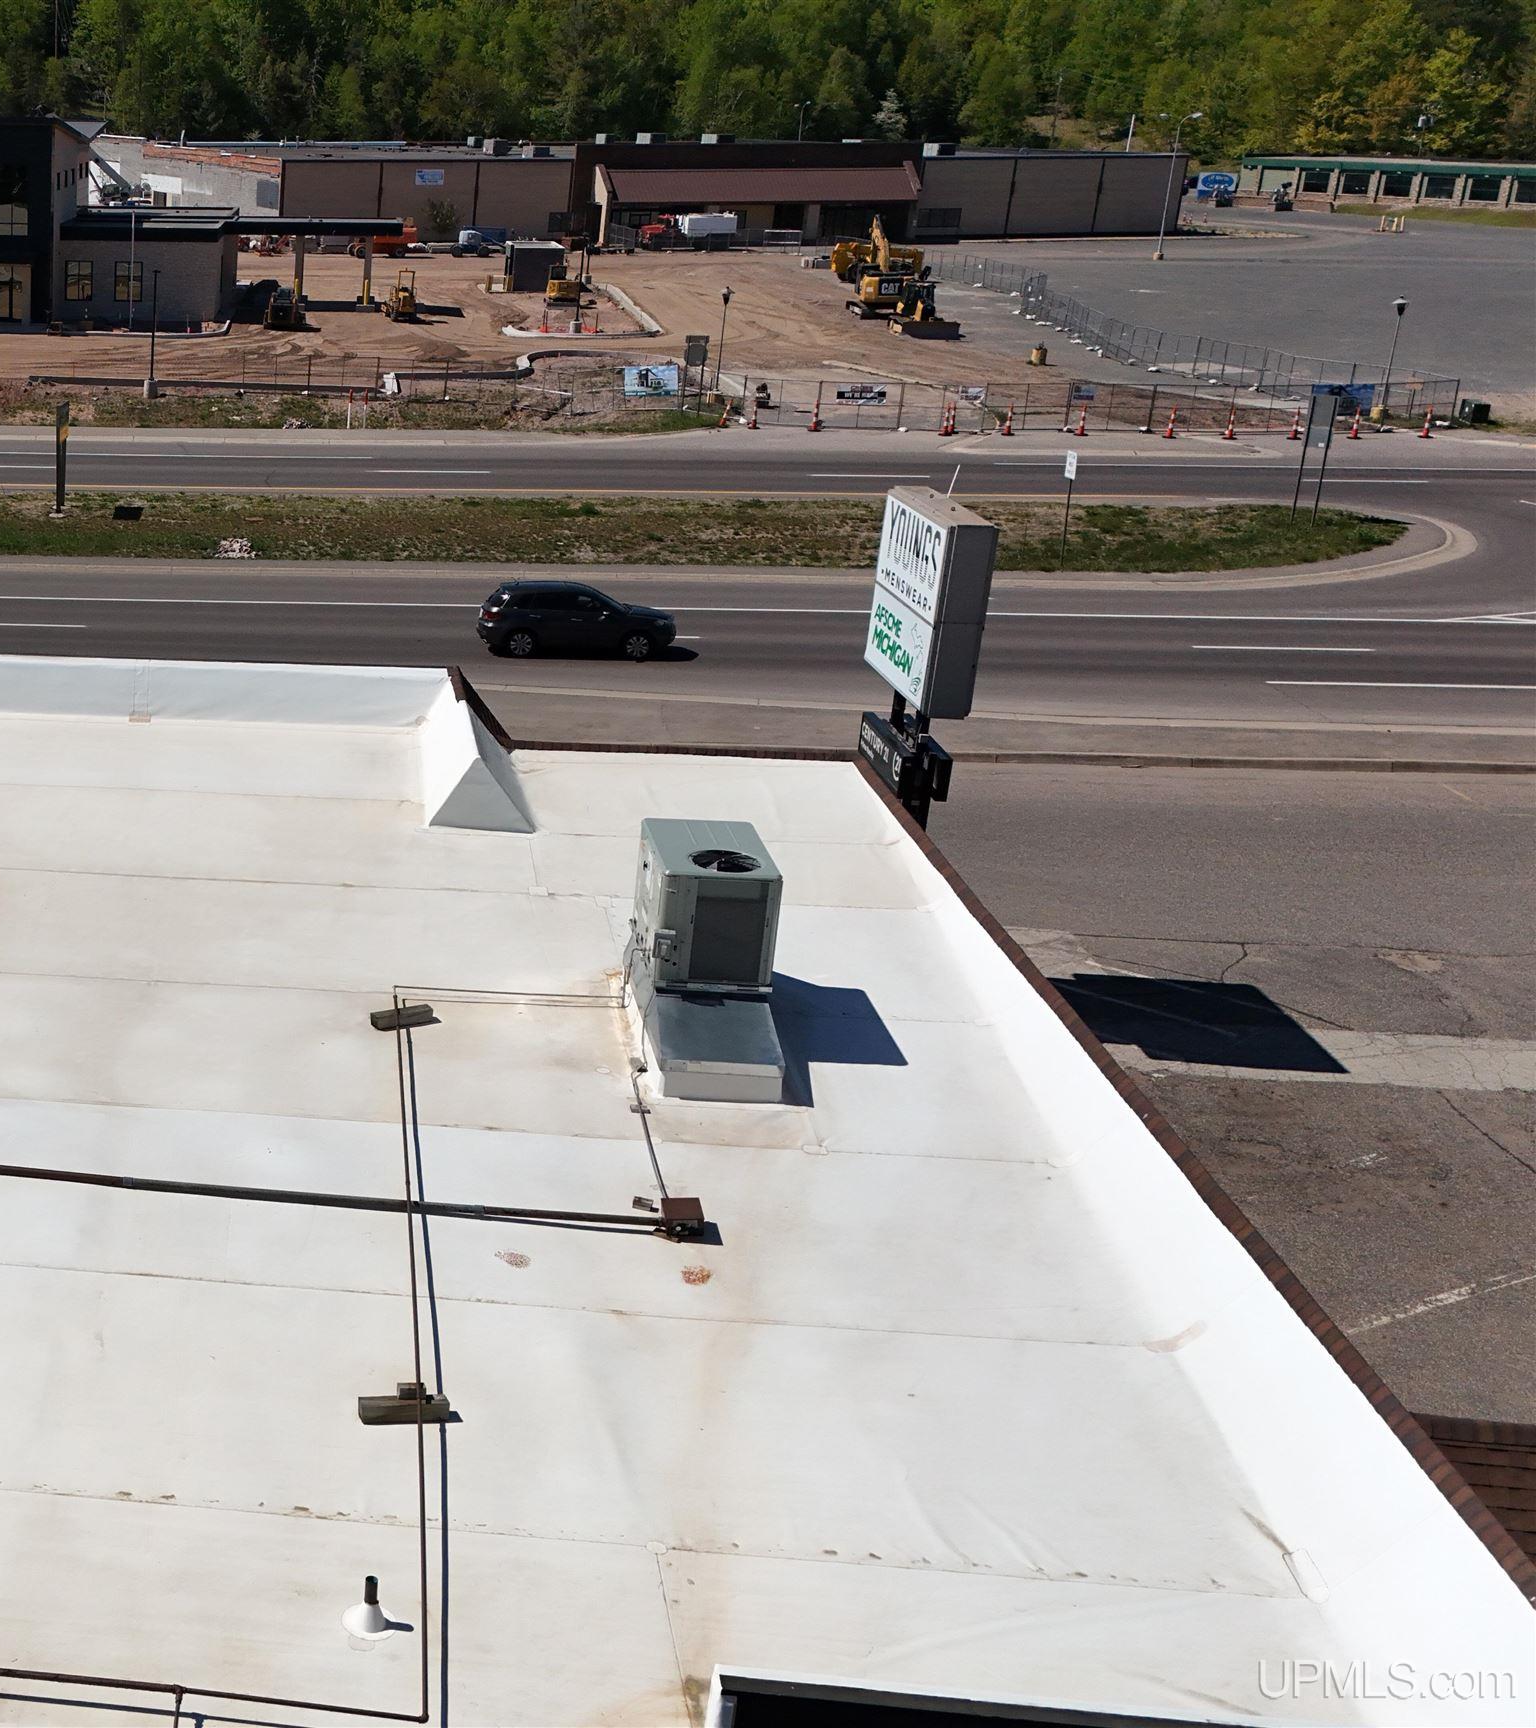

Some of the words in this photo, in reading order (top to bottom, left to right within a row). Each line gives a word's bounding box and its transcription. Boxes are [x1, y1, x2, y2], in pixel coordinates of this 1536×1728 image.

[881, 282, 900, 295] CAT
[887, 501, 941, 591] YOUNGS
[884, 567, 928, 611] MENSWEAR
[874, 603, 903, 639] AFSCME
[871, 624, 914, 678] MICHIGAN
[861, 721, 884, 756] CENTURY
